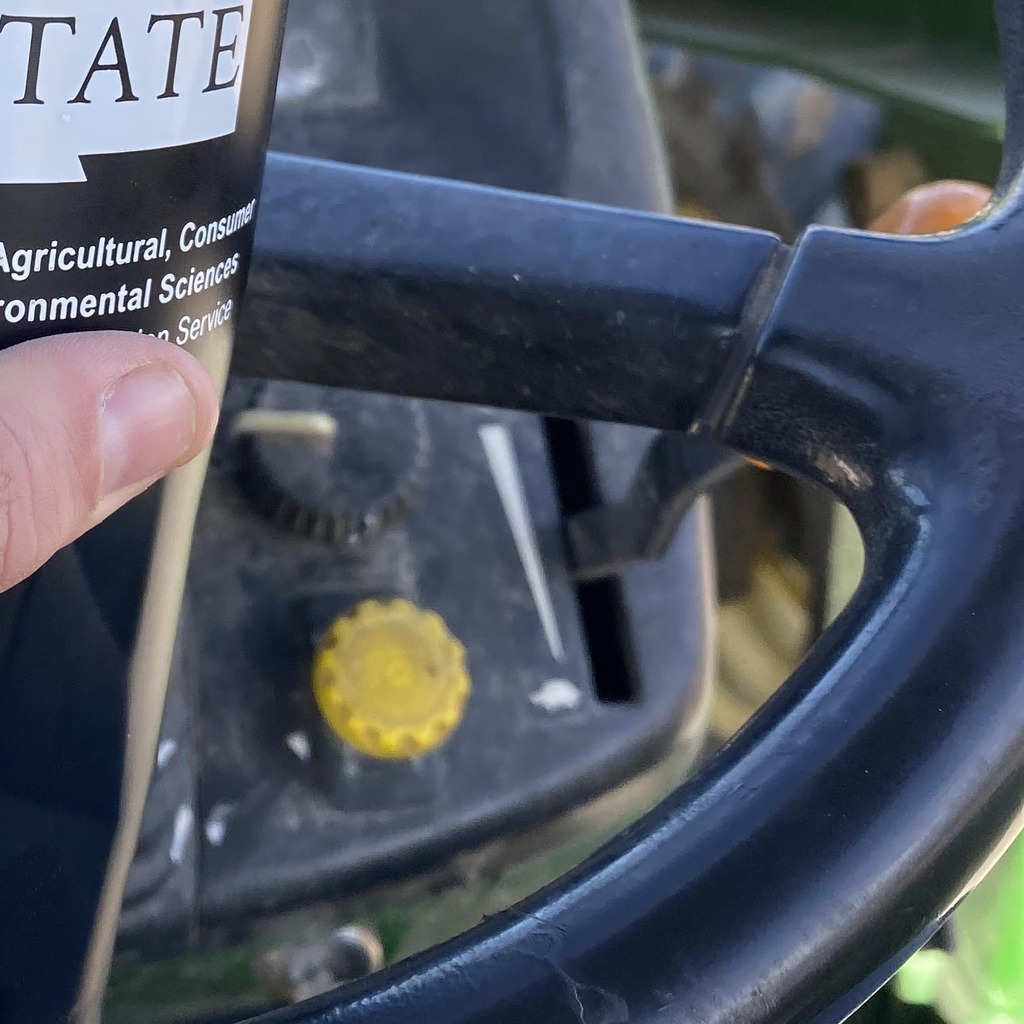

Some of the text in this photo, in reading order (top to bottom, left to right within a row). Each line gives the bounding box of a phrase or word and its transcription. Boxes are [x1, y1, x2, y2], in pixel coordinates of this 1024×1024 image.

[179, 197, 257, 253] Consumer
[159, 252, 240, 304] Sciences
[176, 299, 233, 346] Service
